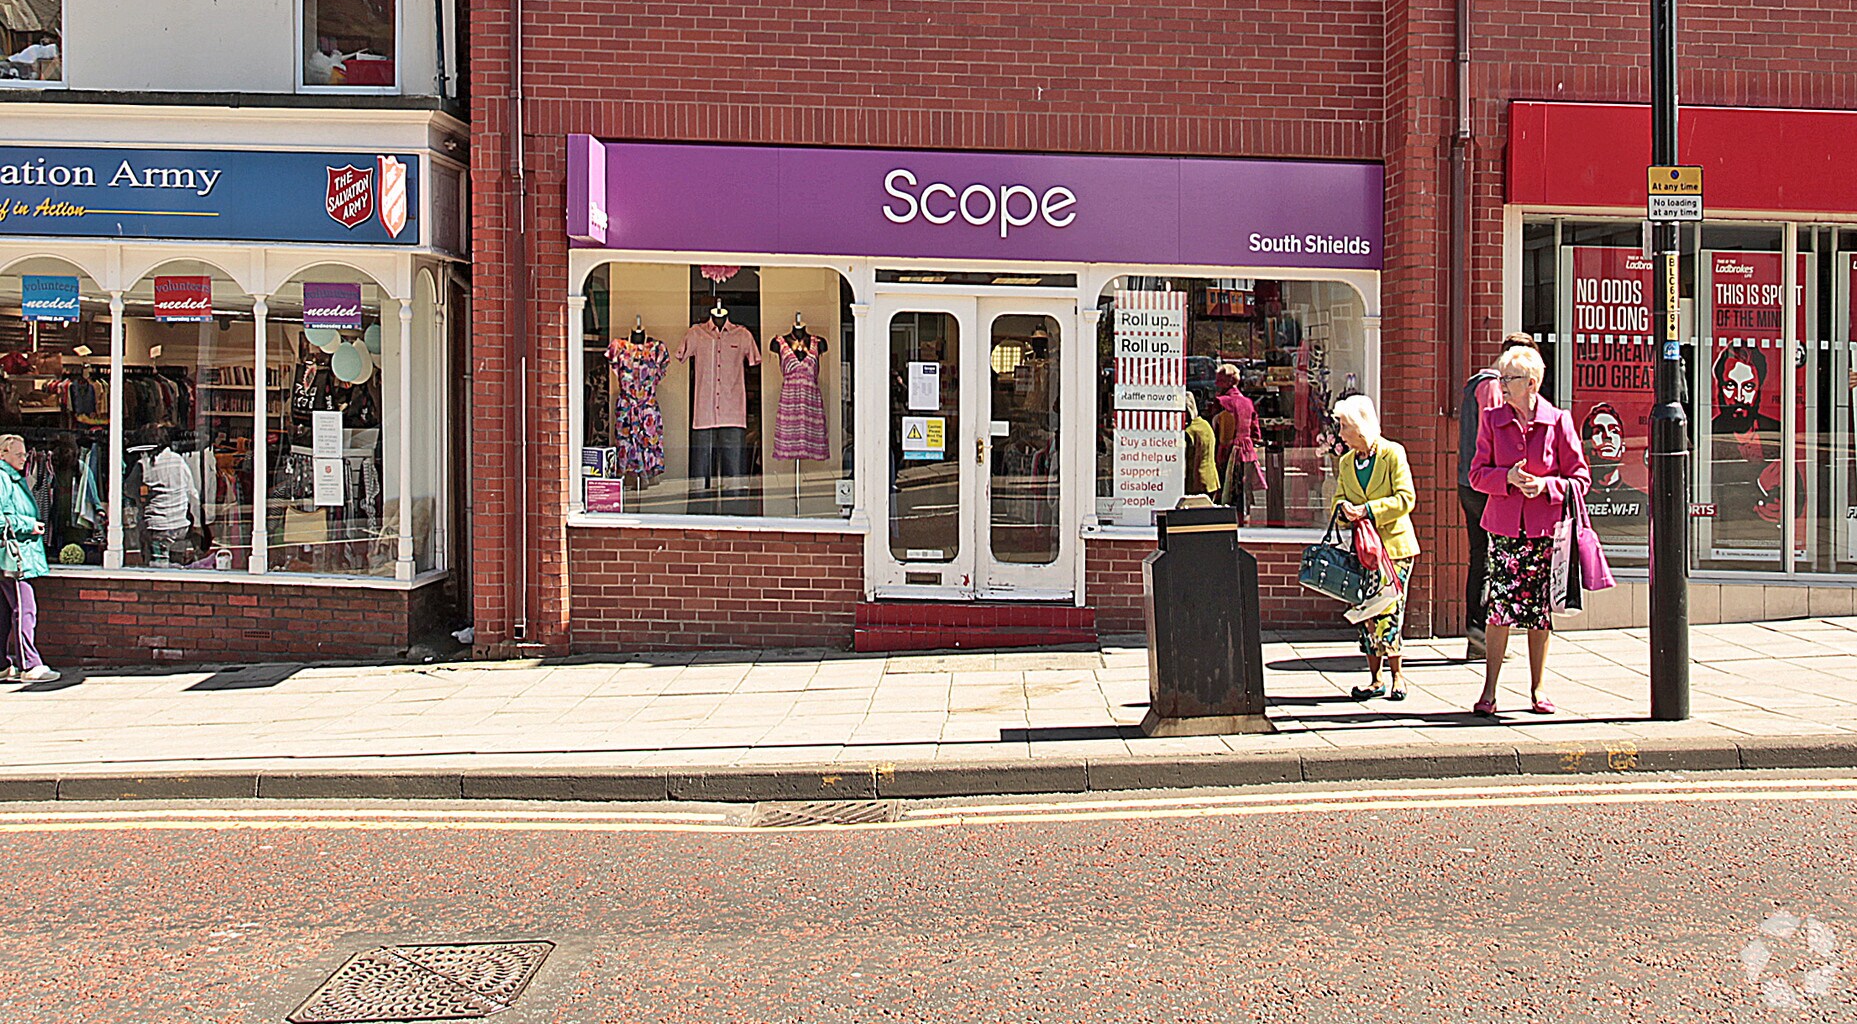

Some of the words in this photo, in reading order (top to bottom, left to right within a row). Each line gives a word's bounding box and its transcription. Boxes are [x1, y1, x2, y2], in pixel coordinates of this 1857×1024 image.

[0, 157, 97, 186] ation
[107, 159, 222, 197] Army
[334, 170, 354, 191] THE
[328, 174, 369, 213] SALVATION
[1652, 182, 1662, 191] At
[1664, 184, 1679, 192] any
[1680, 182, 1699, 191] time
[12, 200, 31, 216] in
[33, 197, 87, 218] Action
[342, 192, 368, 221] ARMY
[882, 168, 1077, 238] Scope
[1653, 198, 1666, 207] No
[1667, 198, 1697, 208] loading
[1248, 233, 1302, 253] South
[1304, 235, 1371, 255] Shields
[1625, 259, 1654, 270] Ladbro
[1715, 264, 1754, 274] Ladbrokes
[23, 279, 79, 294] volunteers
[155, 279, 211, 294] volunteers
[1576, 279, 1597, 304] NO
[1601, 279, 1642, 305] ODDS
[1715, 283, 1745, 305] THIS
[1747, 284, 1759, 305] IS
[1762, 284, 1803, 306] SPT
[26, 297, 77, 310] needed
[158, 297, 208, 310] needed
[307, 305, 358, 316] needed
[1121, 312, 1148, 326] Roll
[1151, 315, 1180, 330] up...
[1576, 305, 1606, 330] TOO
[1609, 306, 1649, 332] LONG
[1717, 309, 1730, 327] OF
[1733, 309, 1754, 327] THE
[1756, 310, 1782, 328] MIN
[1121, 338, 1148, 353] Roll
[1151, 341, 1180, 356] up...
[1576, 364, 1607, 387] TOO
[1611, 364, 1655, 389] GREA
[1121, 391, 1146, 401] Raffle
[1147, 393, 1166, 401] now
[1120, 437, 1139, 449] Buy
[1141, 439, 1147, 447] a
[1149, 437, 1177, 447] ticket
[1120, 452, 1139, 461] and
[1141, 452, 1163, 463] help
[1164, 454, 1177, 462] us
[1120, 467, 1160, 478] support
[1120, 481, 1164, 491] disabled
[1120, 496, 1156, 507] people
